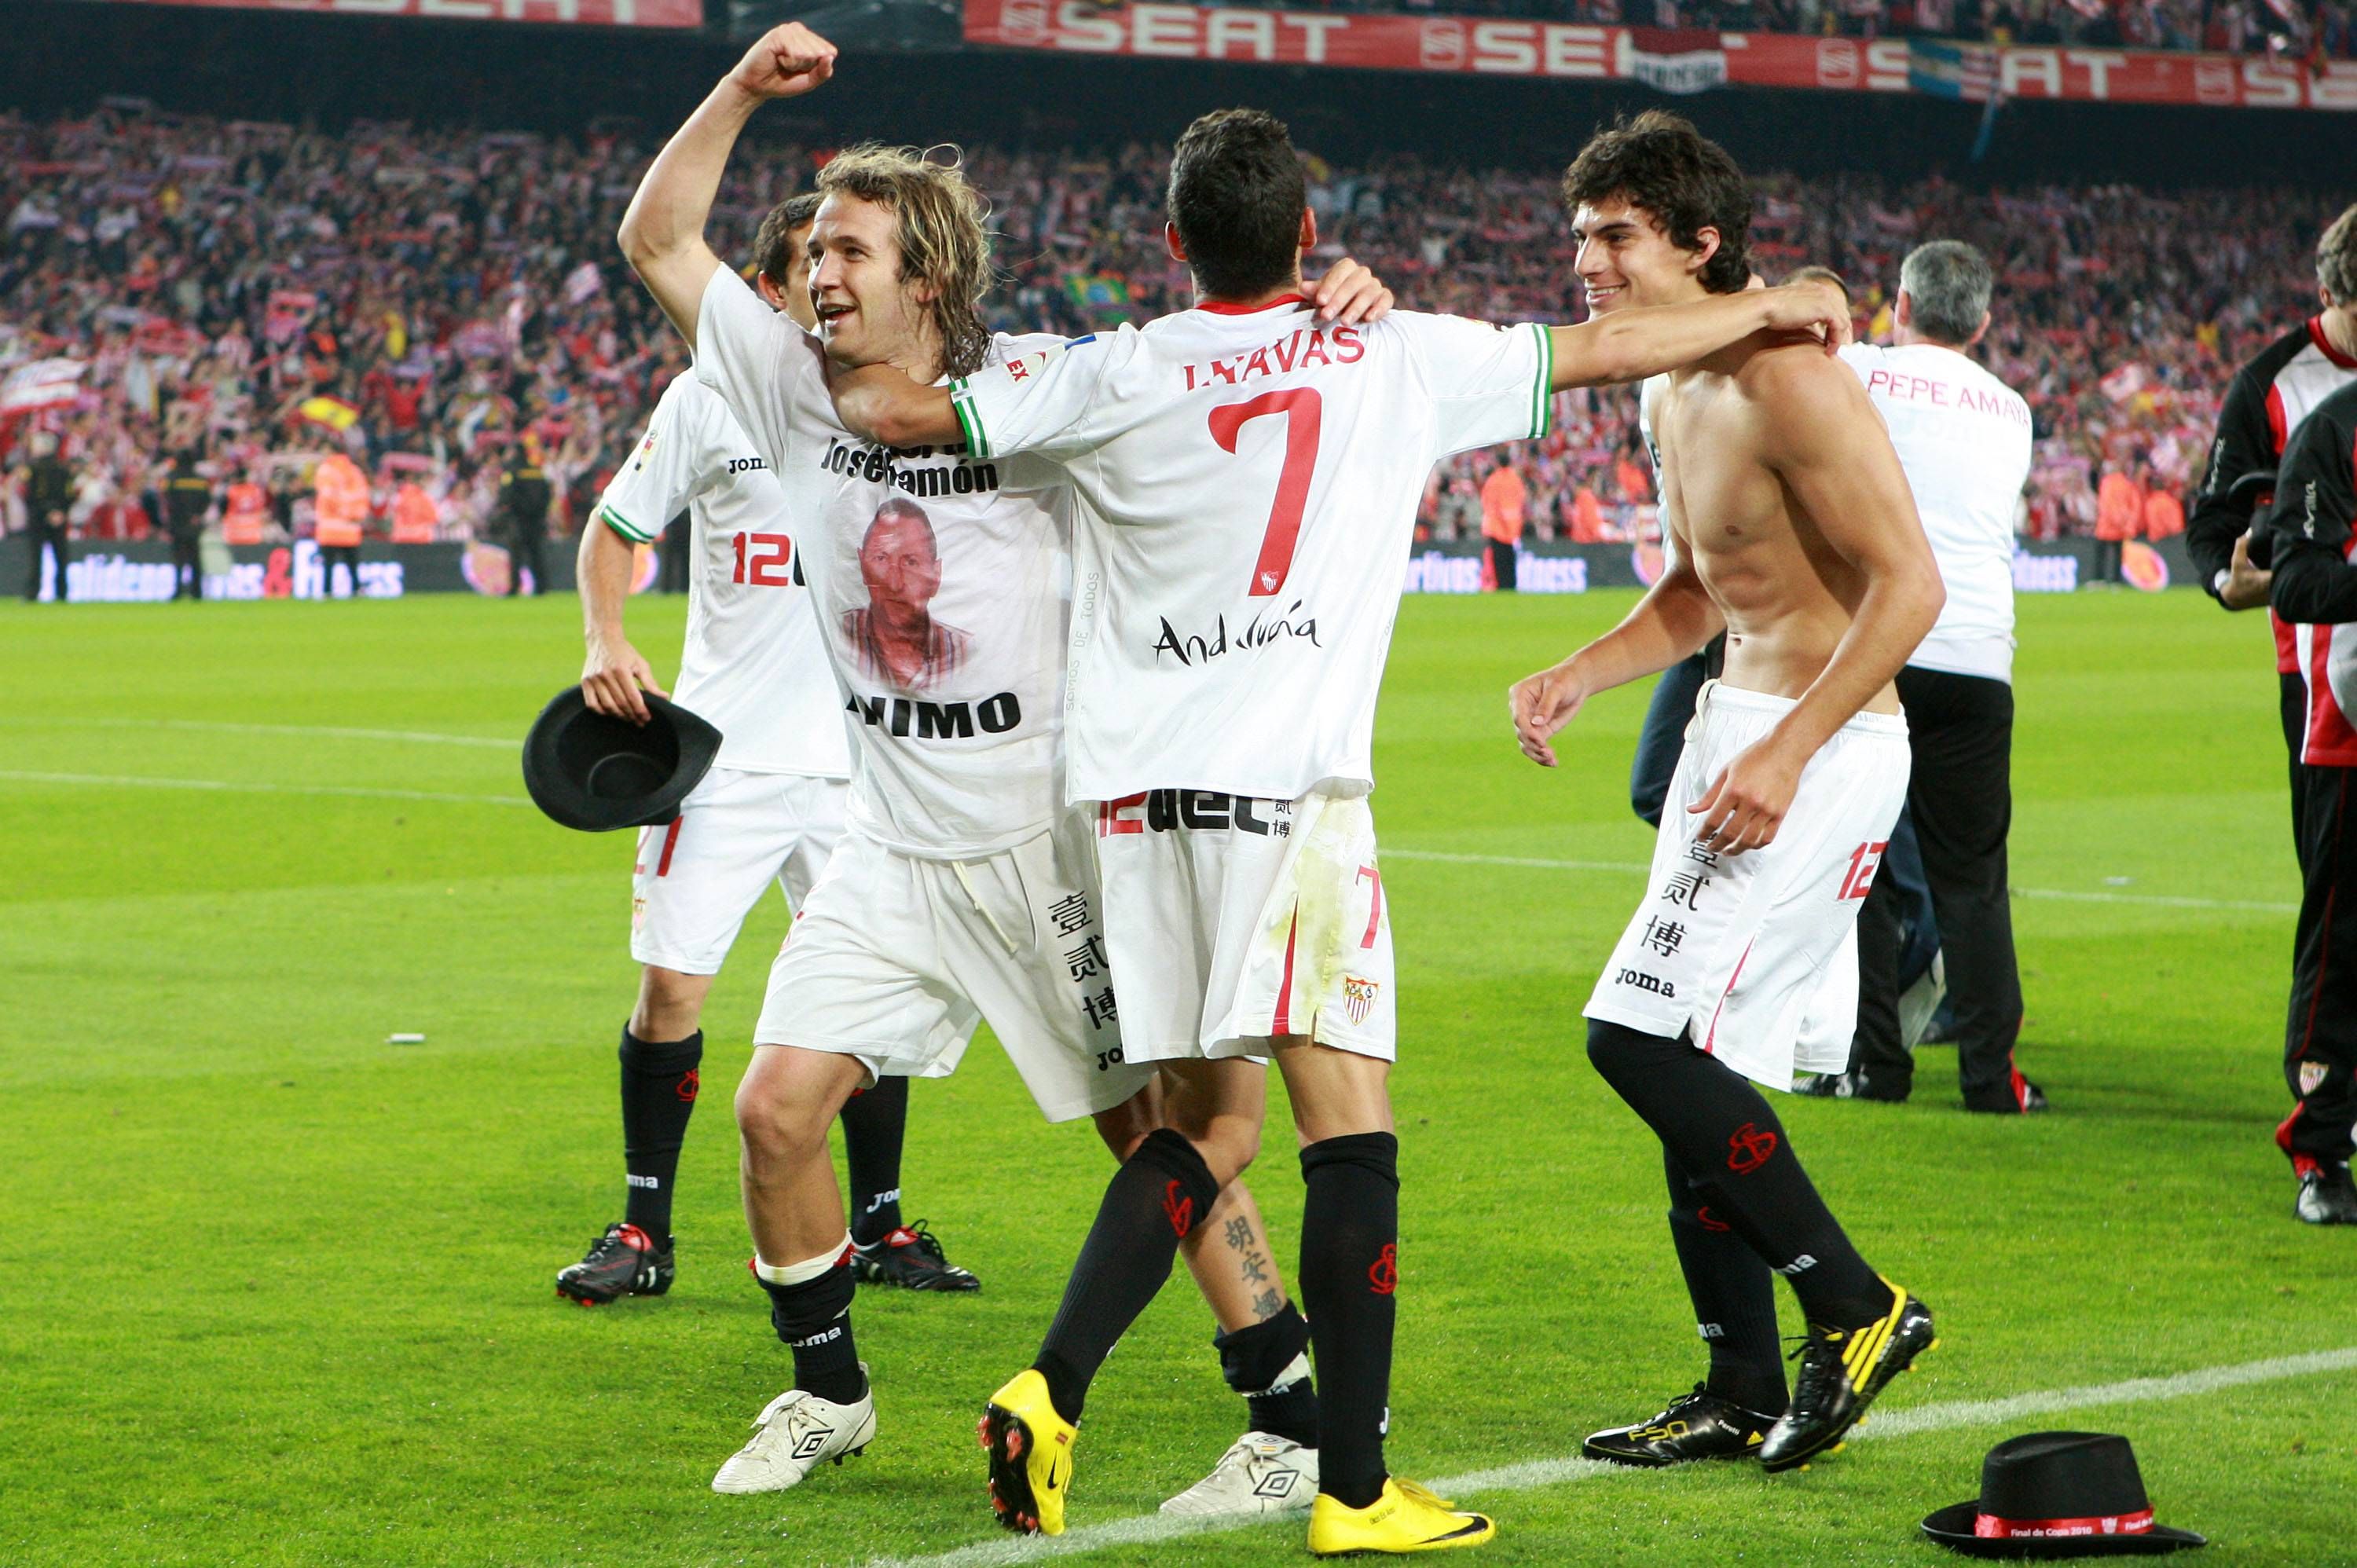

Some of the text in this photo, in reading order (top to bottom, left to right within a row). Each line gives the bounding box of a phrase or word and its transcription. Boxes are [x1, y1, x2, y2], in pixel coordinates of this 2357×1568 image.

[1054, 1, 1350, 63] SEAT
[1867, 41, 2126, 100] SAT
[1868, 369, 1948, 406] PEPE
[1208, 387, 1322, 597] 7
[1065, 572, 1100, 711] SOMOS DE TODOS
[1355, 865, 1381, 950] 7
[2011, 1528, 2031, 1537] Final
[2046, 1527, 2069, 1537] Copa
[2071, 1526, 2092, 1536] 2010
